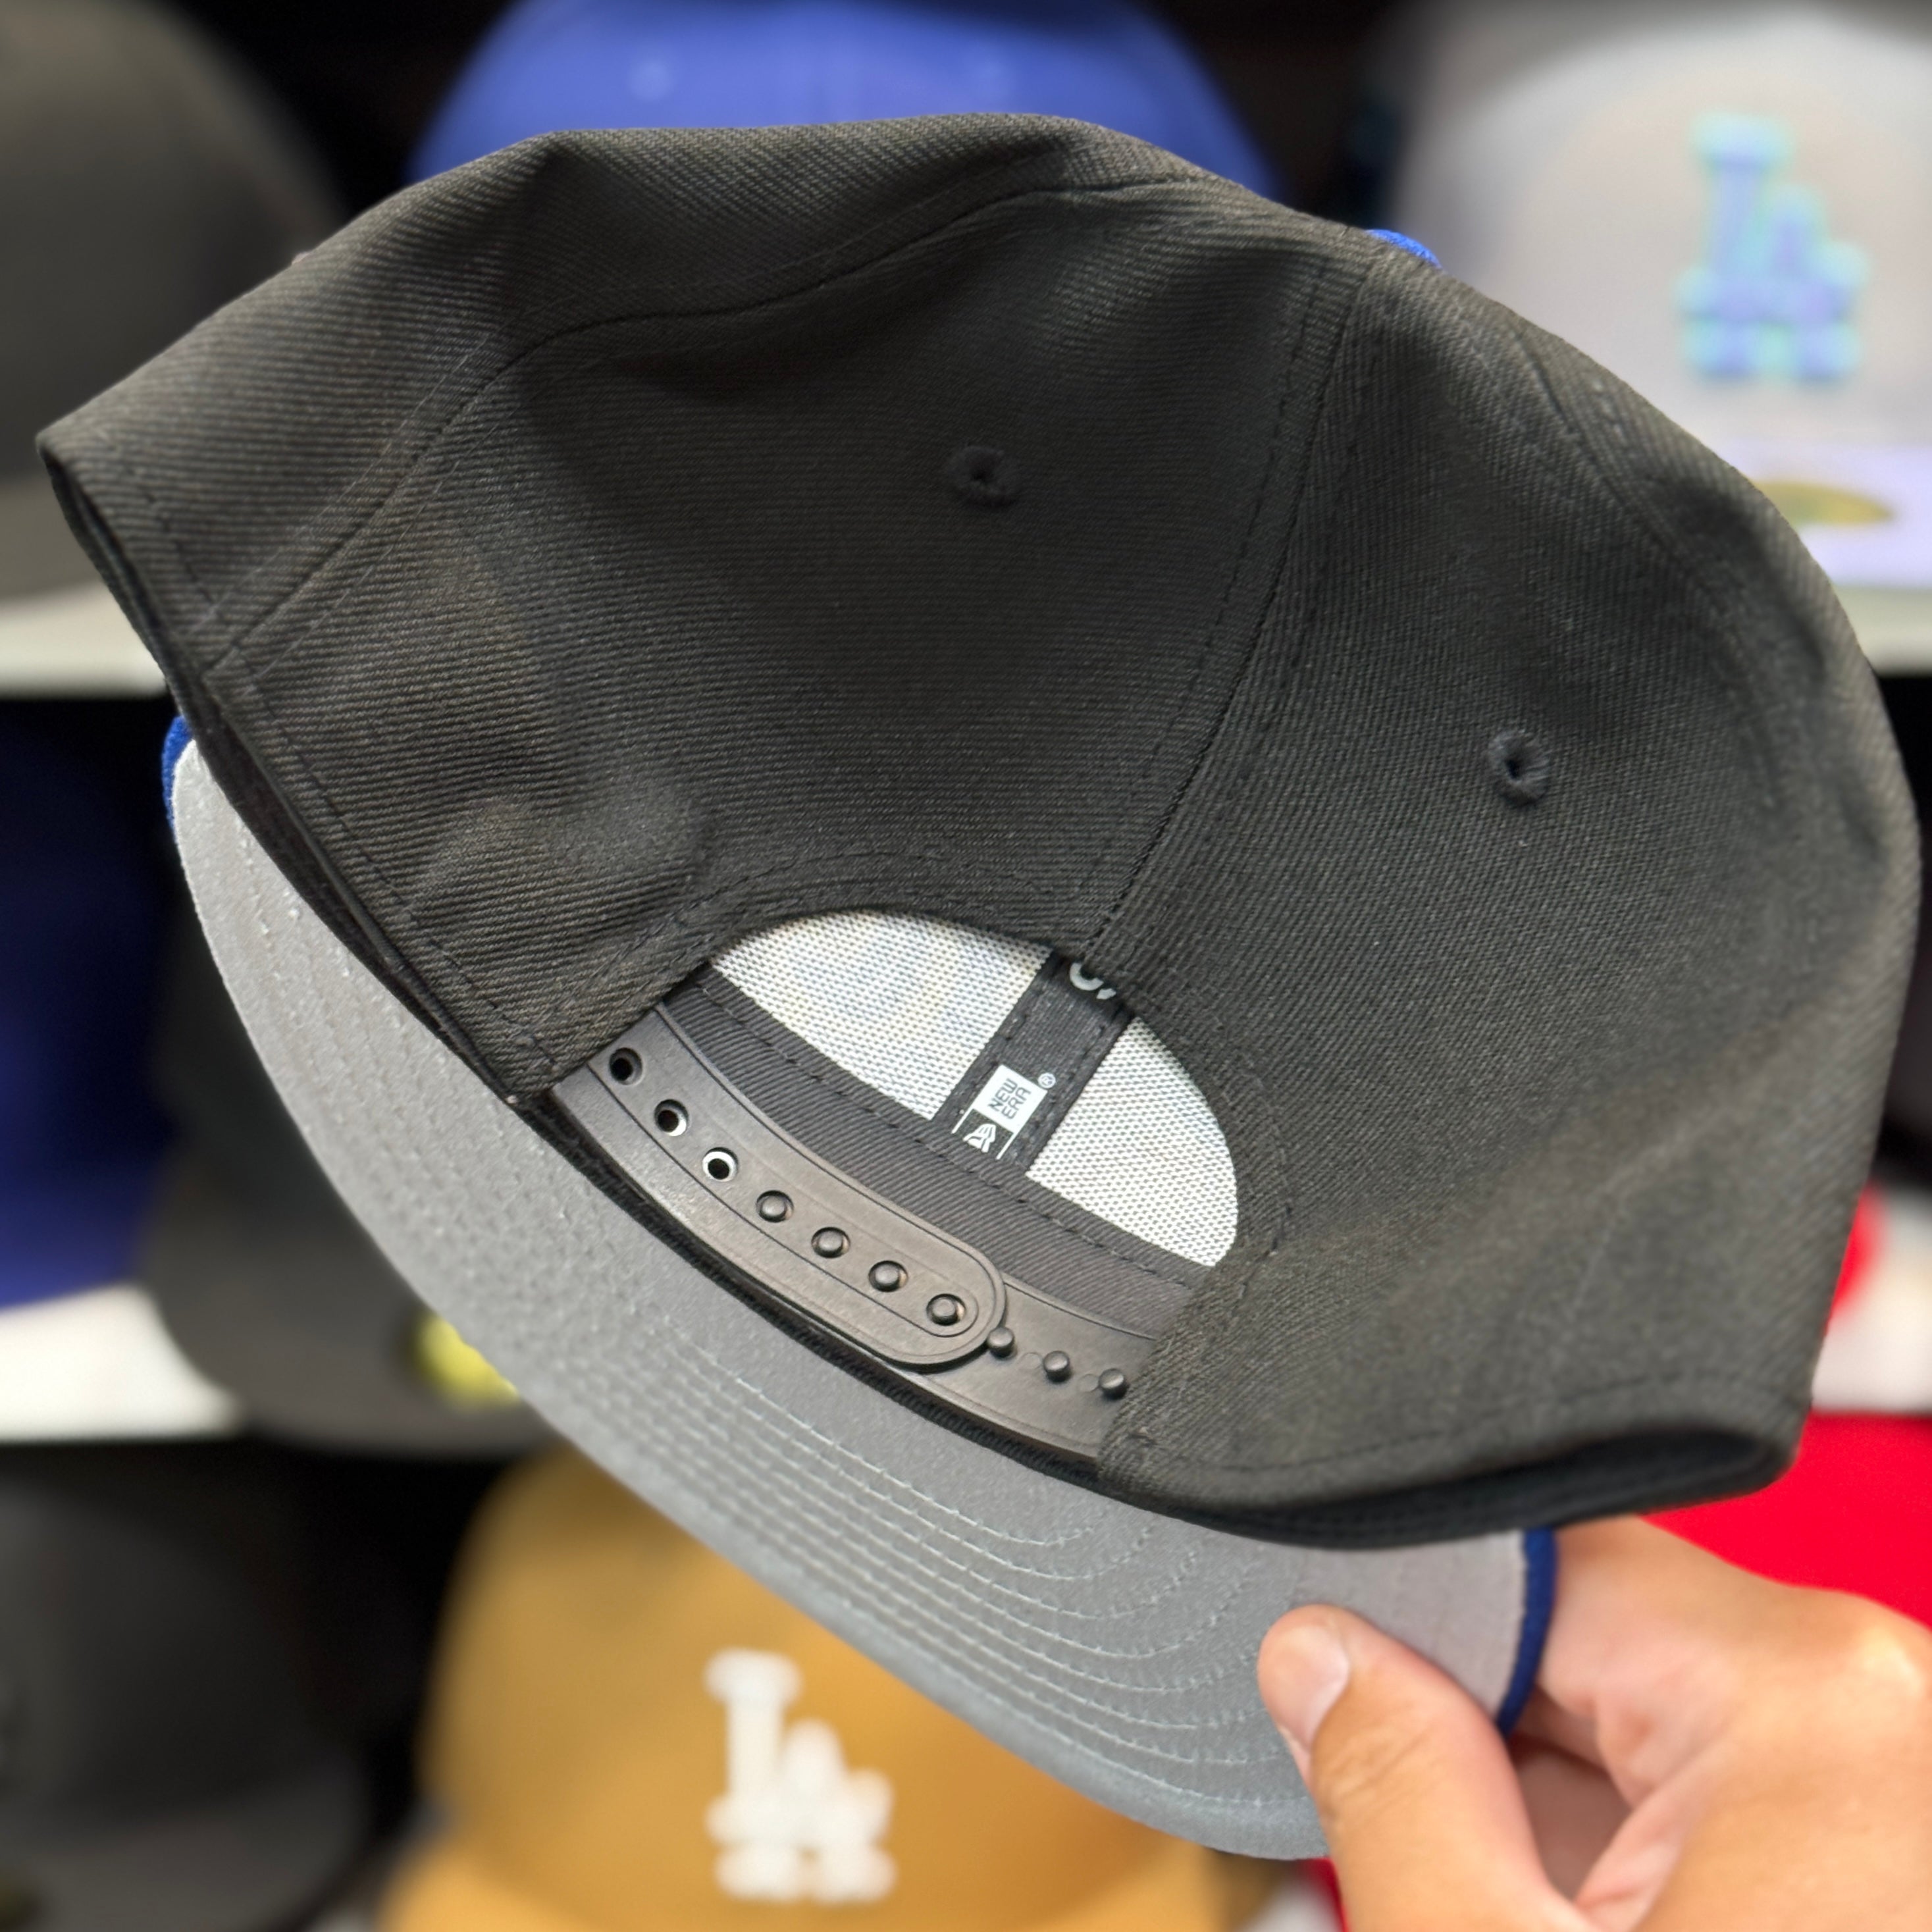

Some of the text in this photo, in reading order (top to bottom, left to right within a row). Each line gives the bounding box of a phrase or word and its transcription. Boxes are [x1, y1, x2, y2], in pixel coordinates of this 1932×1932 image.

[1676, 112, 1867, 383] LA
[987, 1078, 1018, 1111] NEW
[1001, 1087, 1031, 1120] ERA
[703, 1647, 897, 1902] LA
